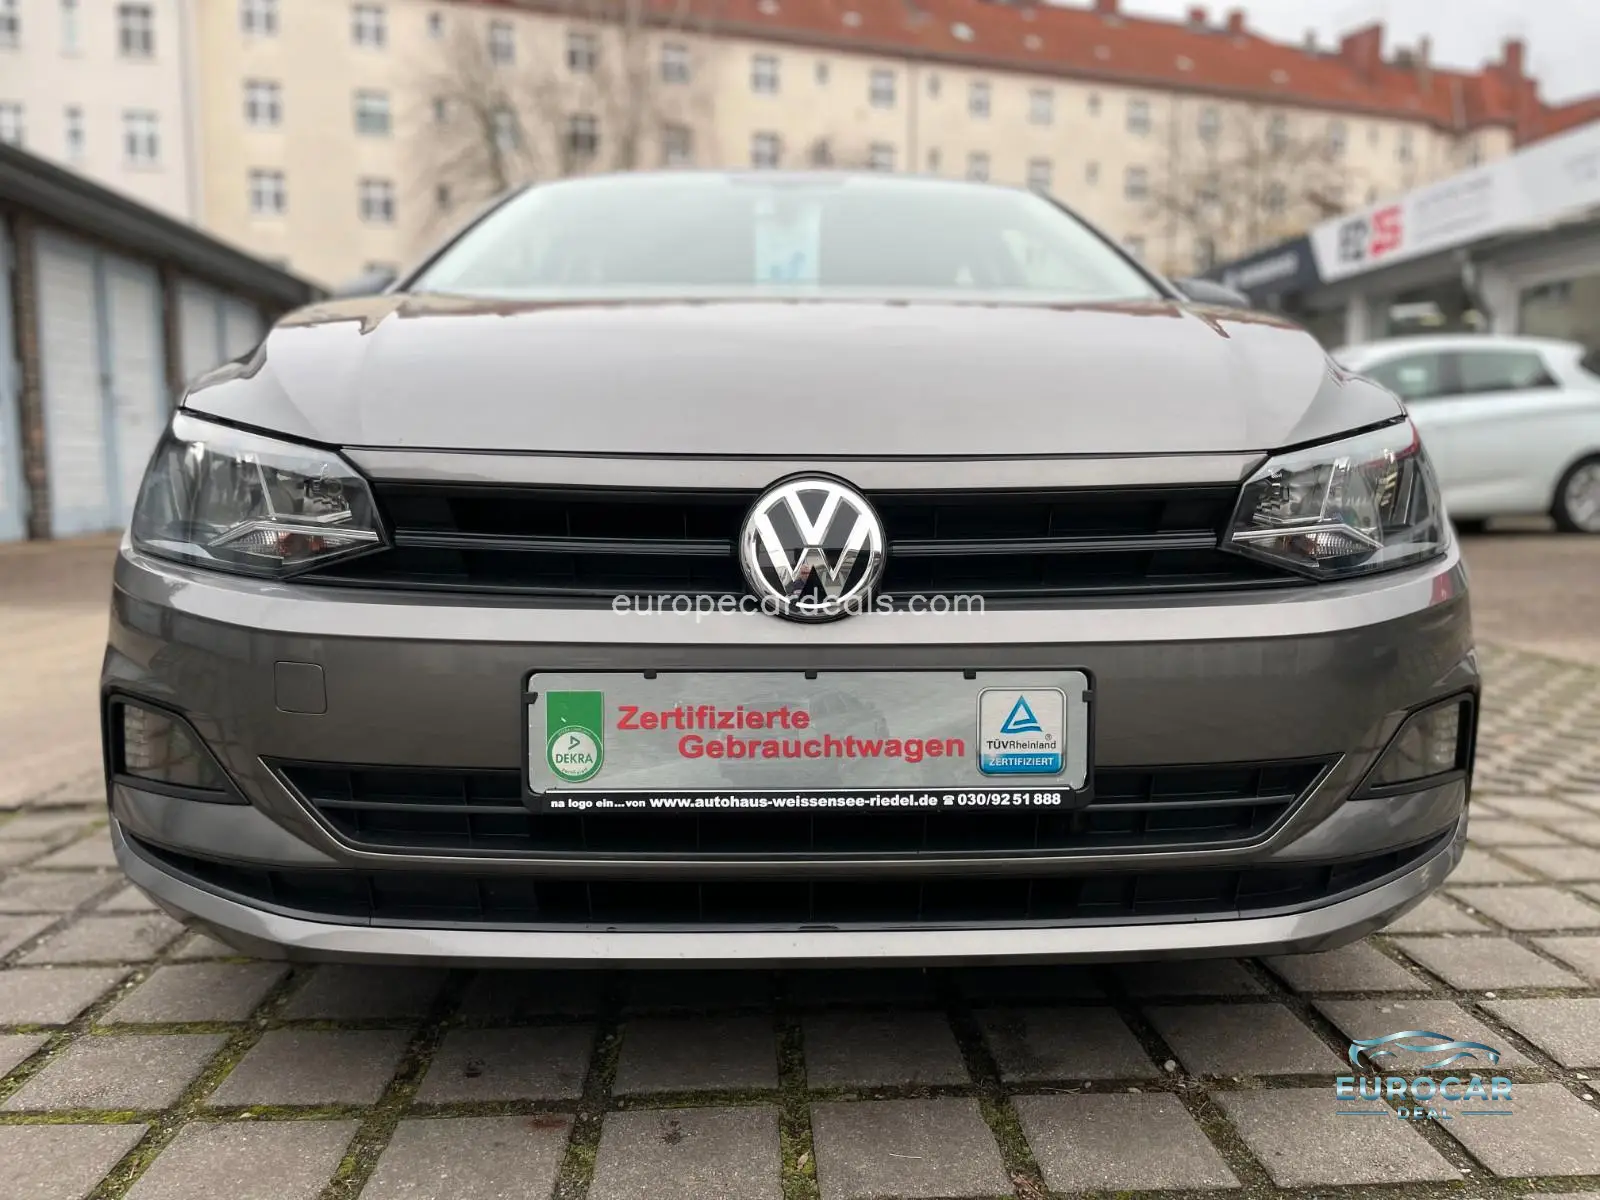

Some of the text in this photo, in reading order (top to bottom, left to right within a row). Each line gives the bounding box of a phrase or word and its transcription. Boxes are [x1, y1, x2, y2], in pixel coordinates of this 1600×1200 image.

[616, 705, 811, 730] Zertifizierte
[678, 734, 966, 763] Gebrauchtwagen
[555, 753, 594, 764] DEKRA
[988, 757, 1054, 766] ZERTIFIZIERT
[550, 800, 565, 808] na
[568, 798, 593, 810] logo
[649, 794, 938, 808] www.autohaus-weissensee-riedel.de
[957, 793, 1011, 806] 030/92
[1012, 793, 1030, 806] 51
[1033, 792, 1061, 805] 888
